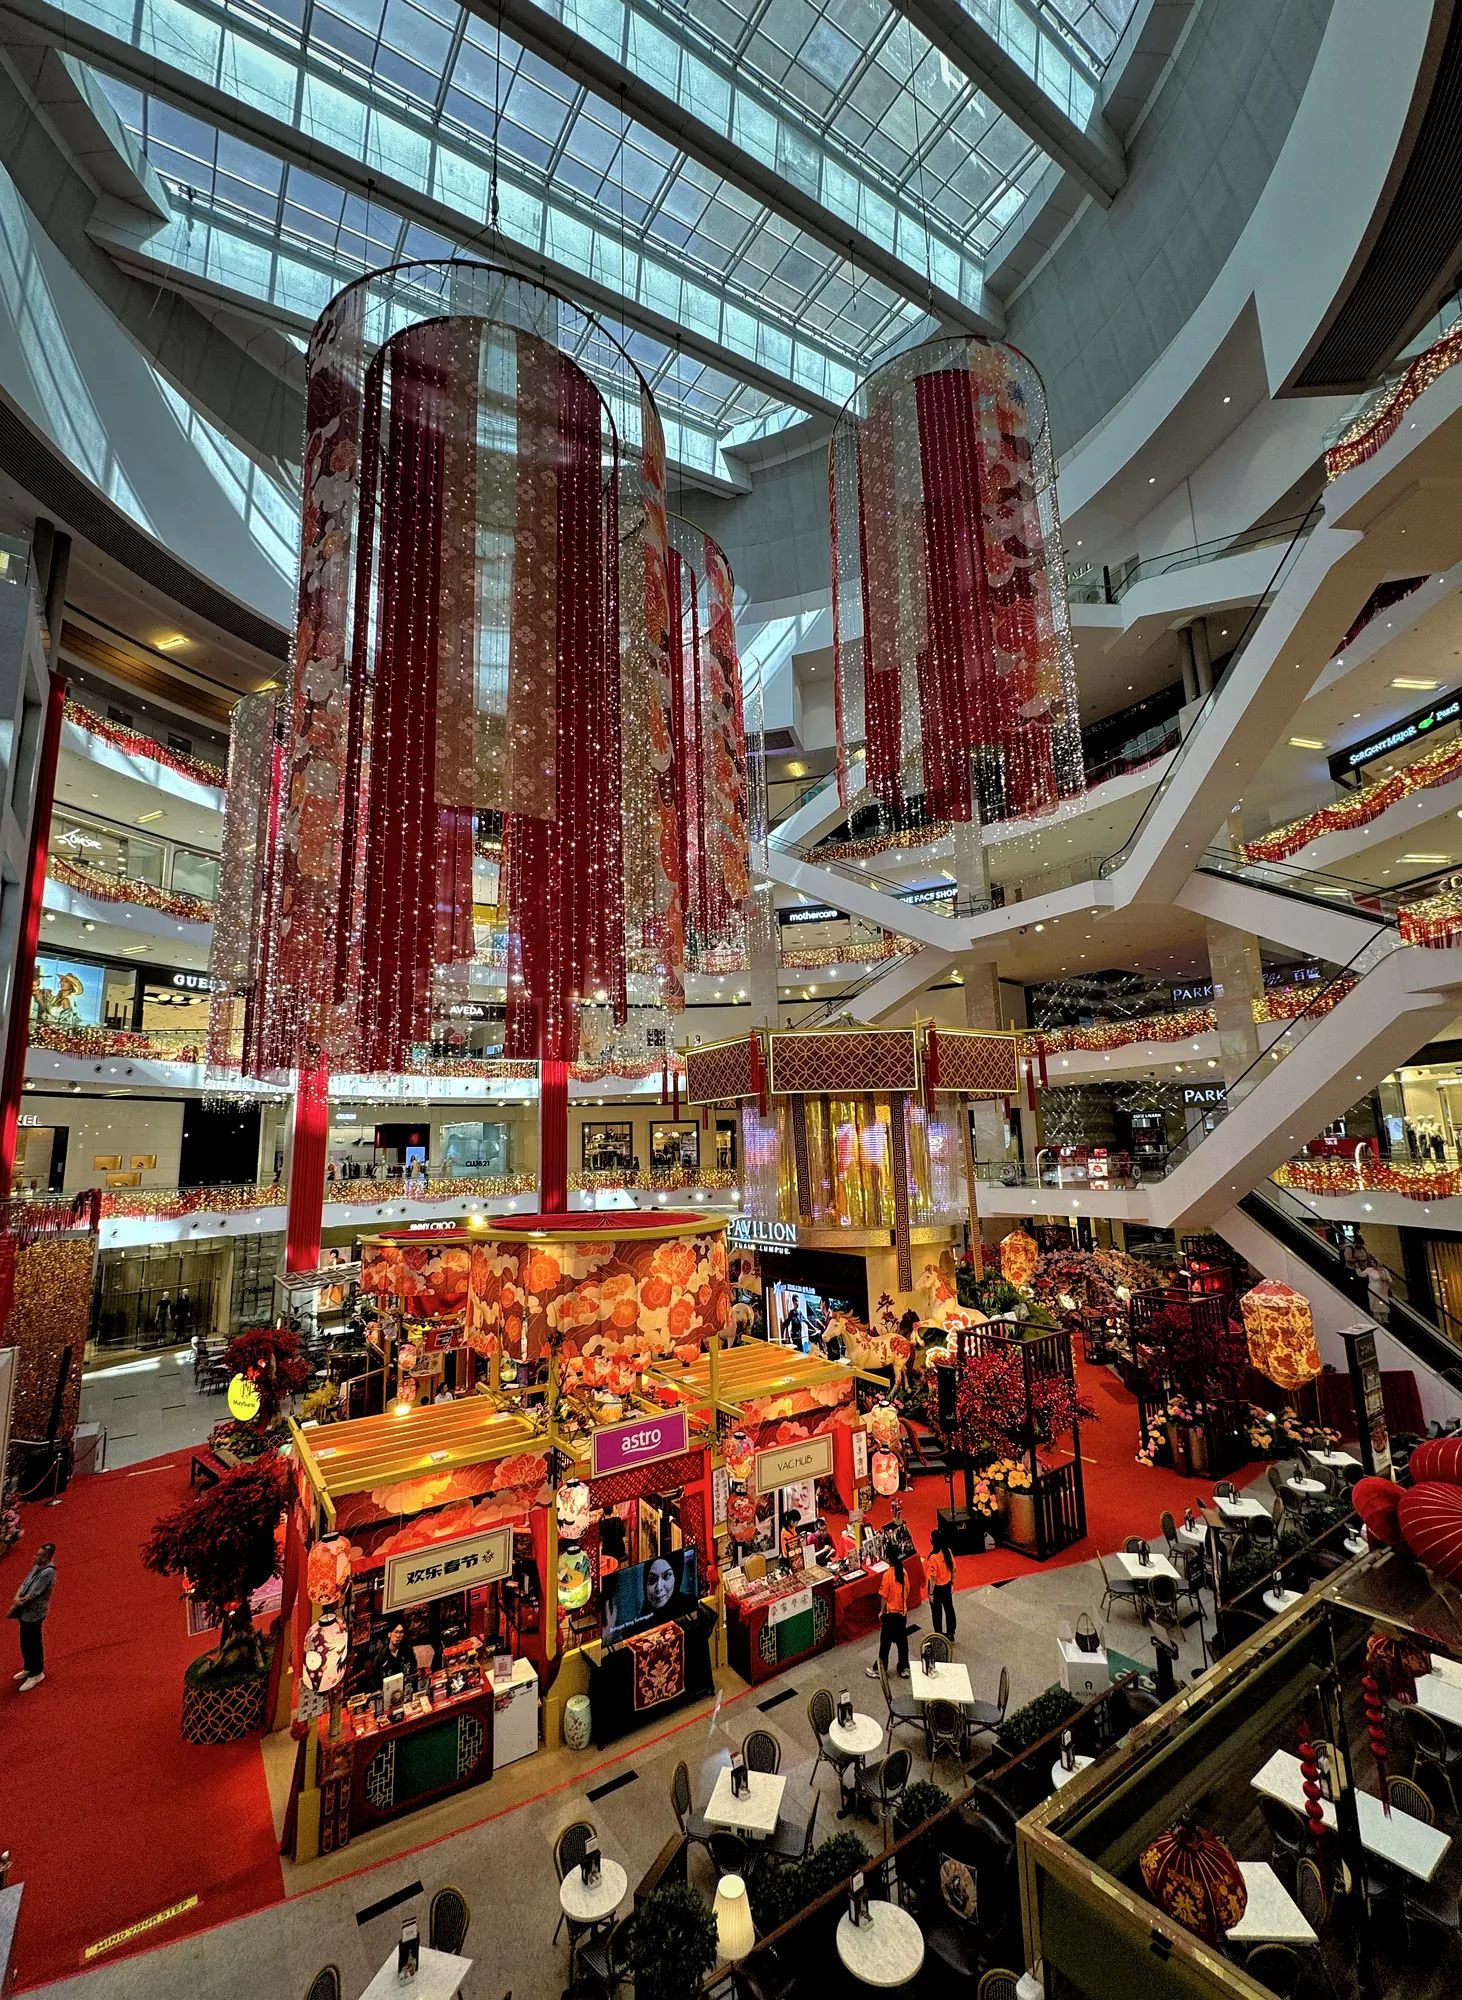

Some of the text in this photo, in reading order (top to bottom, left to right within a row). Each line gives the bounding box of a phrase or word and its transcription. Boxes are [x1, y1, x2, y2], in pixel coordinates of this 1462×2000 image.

[789, 910, 838, 922] mothercare
[1173, 984, 1213, 1001] PARK
[450, 1005, 484, 1017] AVEDA
[1184, 1088, 1226, 1102] PARK
[727, 1219, 797, 1242] PAVILION
[233, 1400, 256, 1408] Maybank
[621, 1428, 661, 1451] astro
[406, 1553, 479, 1586] 欢乐春节
[97, 1900, 189, 1952] MIND YOUR STEP
